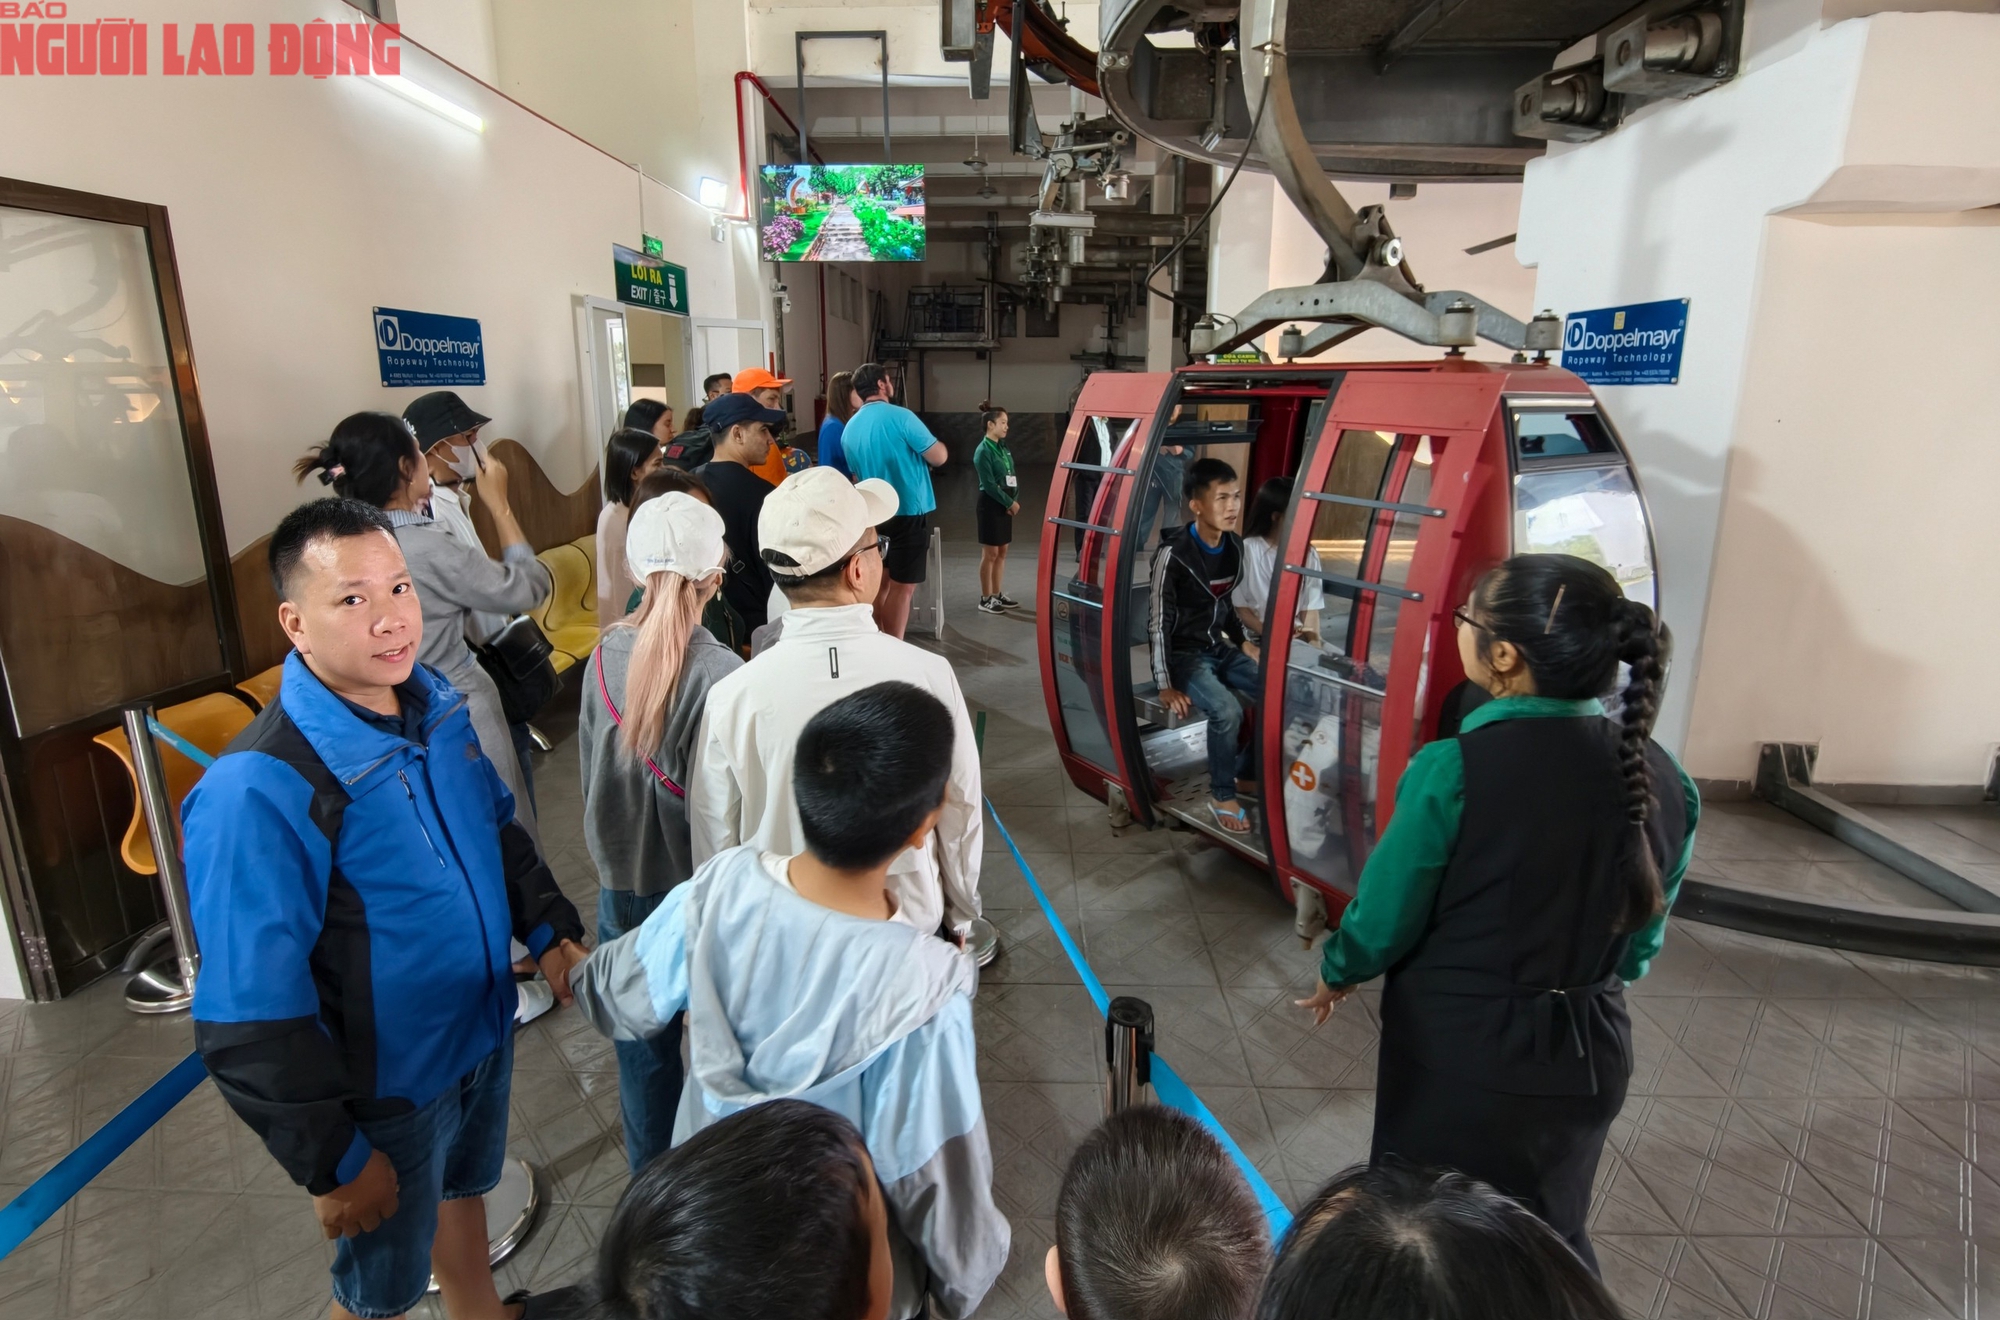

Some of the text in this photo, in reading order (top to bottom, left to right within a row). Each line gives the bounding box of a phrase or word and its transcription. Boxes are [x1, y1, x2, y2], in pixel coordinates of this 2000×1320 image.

[649, 268, 663, 286] RA
[631, 284, 648, 301] EXIT
[1584, 327, 1681, 351] Doppelmayr
[387, 355, 479, 369] Ropeway Technology
[1567, 352, 1673, 366] Ropeway Technology
